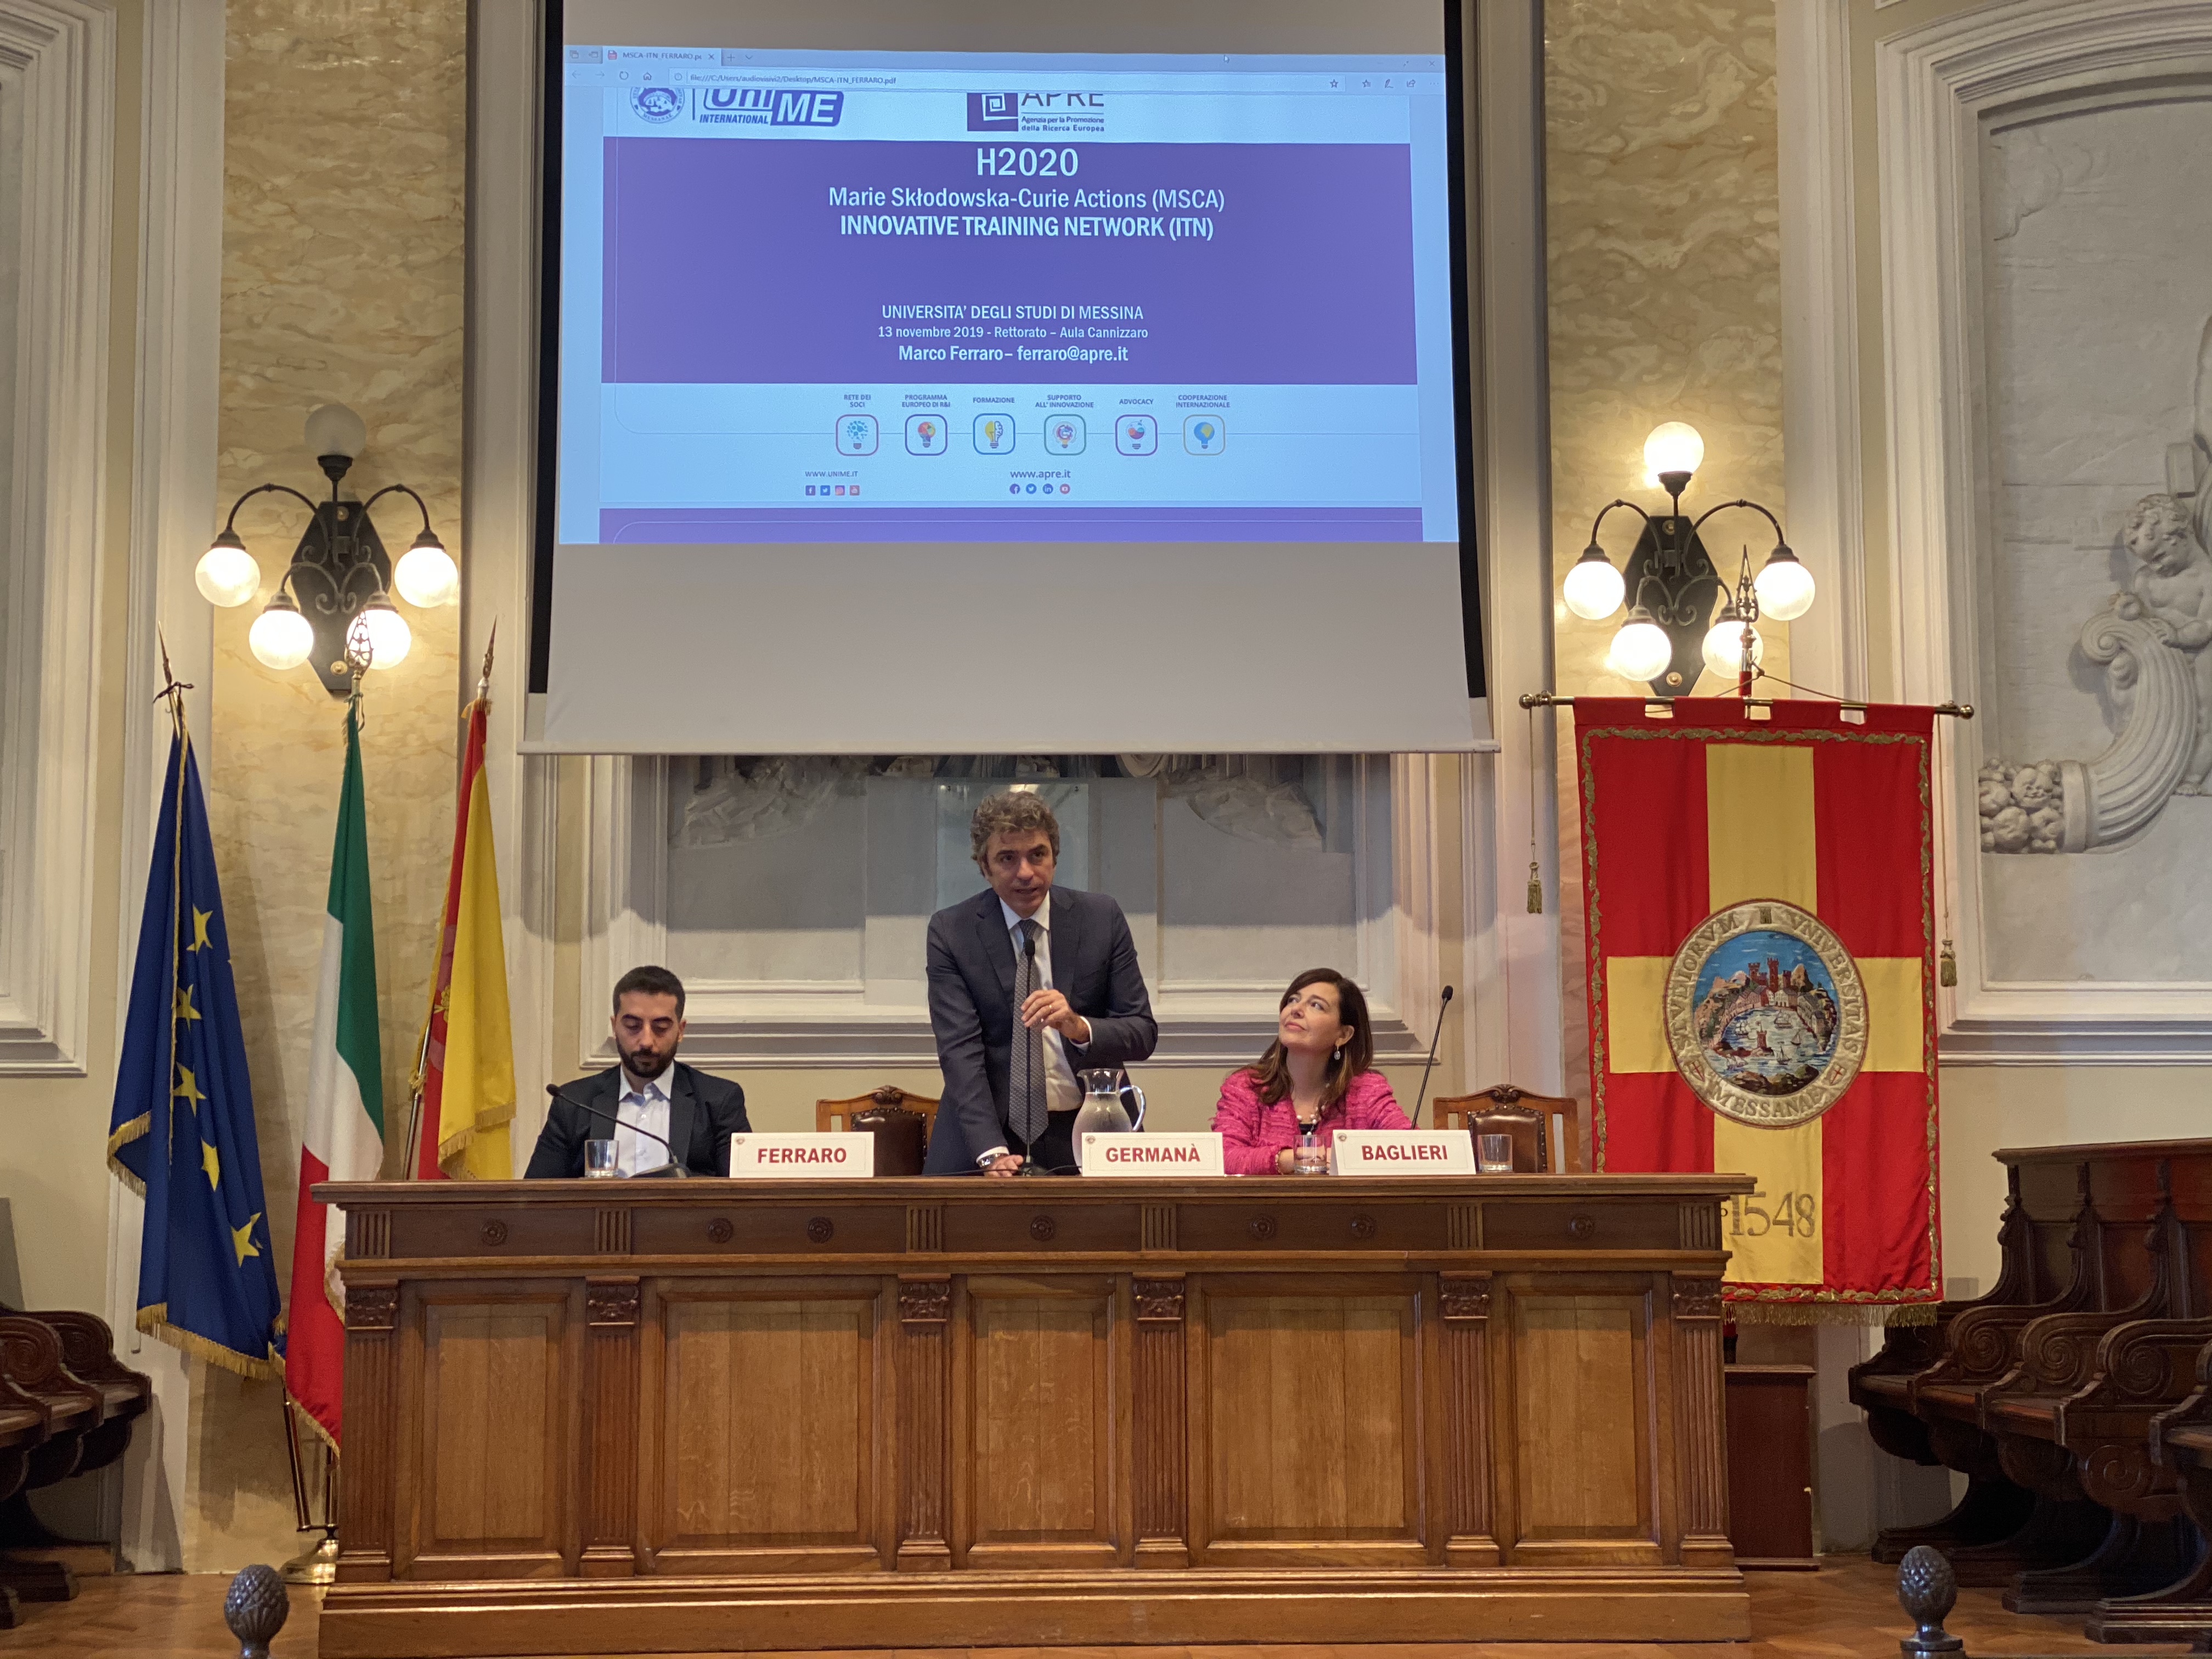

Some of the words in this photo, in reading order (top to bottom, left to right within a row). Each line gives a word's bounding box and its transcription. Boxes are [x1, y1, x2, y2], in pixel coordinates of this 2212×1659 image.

[699, 114, 768, 124] INTERNATIONAL
[1073, 125, 1104, 133] Europea
[977, 148, 1079, 177] H2020
[828, 187, 885, 207] Marie
[891, 187, 1069, 207] Skłodowska-Curie
[1074, 188, 1147, 208] Actions
[1152, 189, 1224, 212] (MSCA)
[840, 215, 958, 235] INNOVATIVE
[962, 216, 1058, 236] TRAINING
[1064, 217, 1165, 236] NETWORK
[1169, 217, 1214, 241] (ITN)
[970, 305, 1012, 319] DEGLI
[1015, 305, 1057, 319] STUDI
[1061, 306, 1075, 319] DI
[1079, 306, 1143, 319] MESSINA
[878, 326, 893, 337] 13
[896, 326, 951, 338] novembre
[953, 326, 984, 338] 2019
[995, 327, 1047, 338] Rettorato
[1059, 327, 1085, 338] Aula
[1088, 328, 1148, 338] Cannizzaro
[899, 346, 946, 360] Marco
[1017, 346, 1128, 364] ferraro@apre.it
[1010, 470, 1071, 480] www.apre.it
[758, 1148, 847, 1163] FERRARO
[1105, 1143, 1200, 1162] GERMANÀ
[1362, 1145, 1448, 1161] BAGLIERI
[1729, 1191, 1815, 1238] 1548
